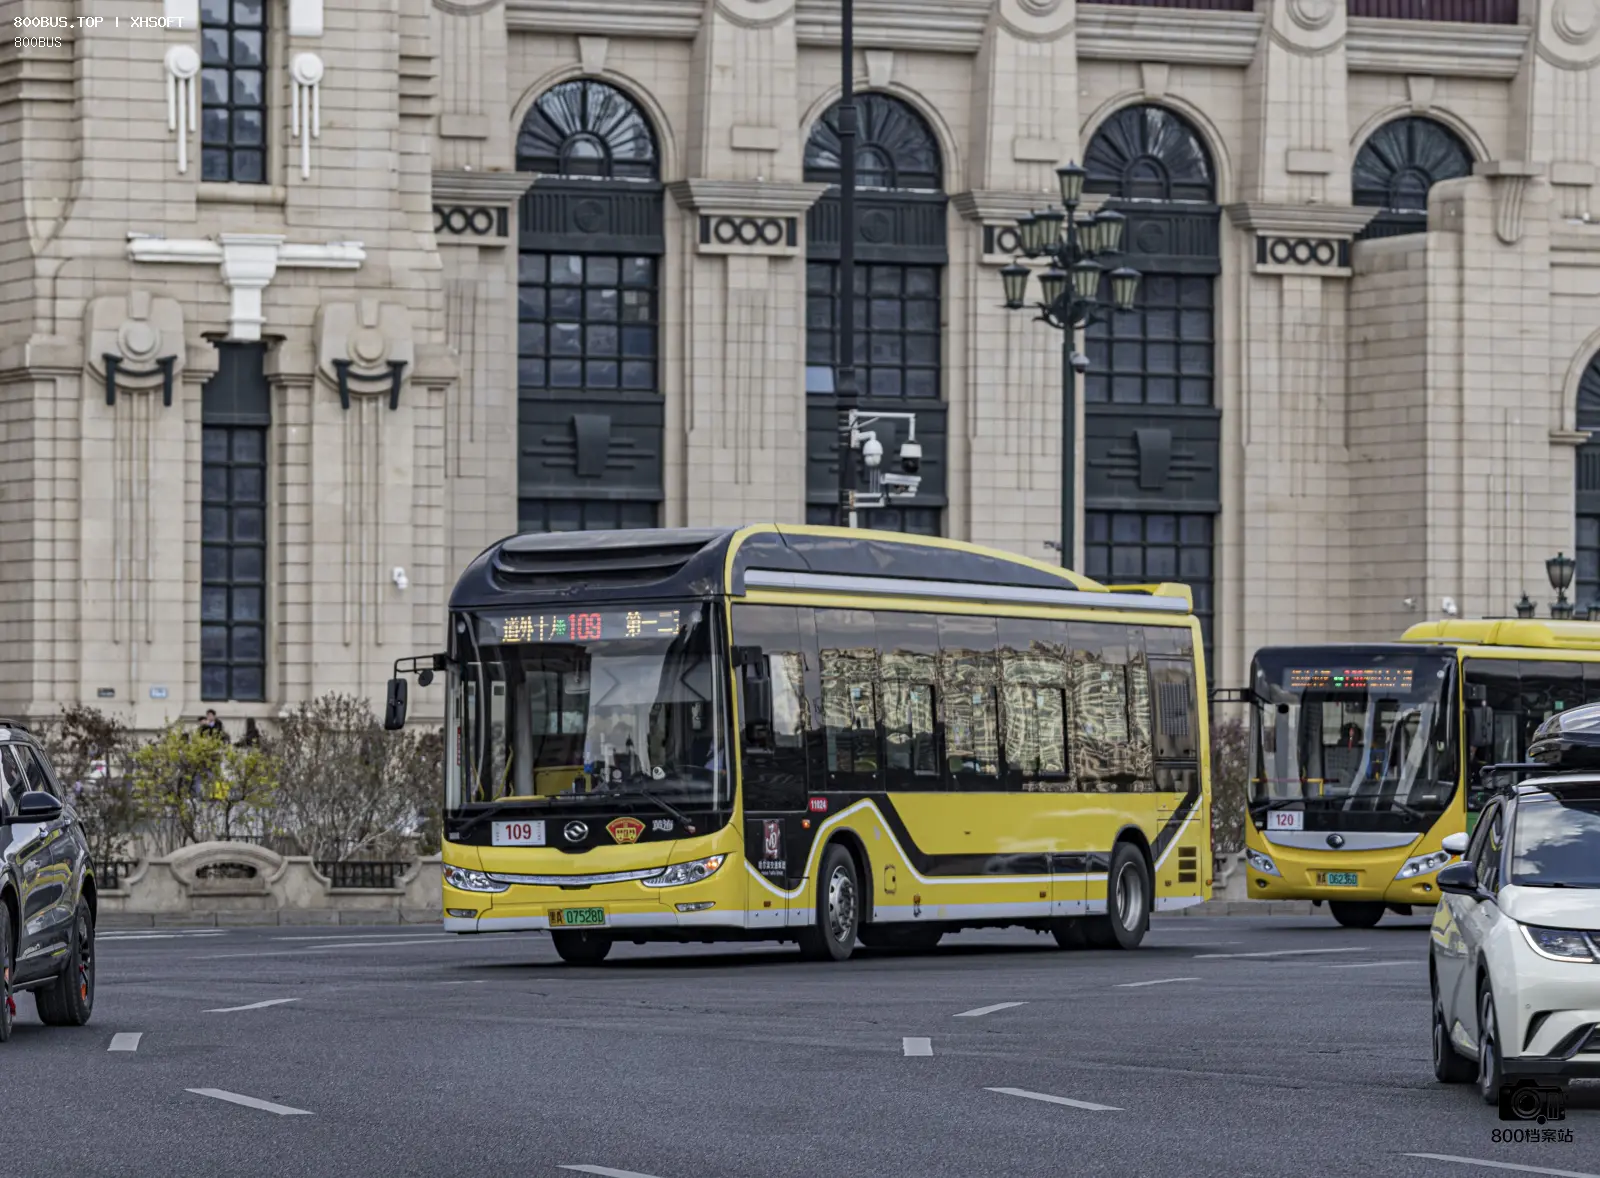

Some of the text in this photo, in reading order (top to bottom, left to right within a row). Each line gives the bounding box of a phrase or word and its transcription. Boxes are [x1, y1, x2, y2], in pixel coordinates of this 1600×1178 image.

[568, 613, 601, 641] 109
[1276, 813, 1295, 826] 120
[505, 823, 532, 840] 109
